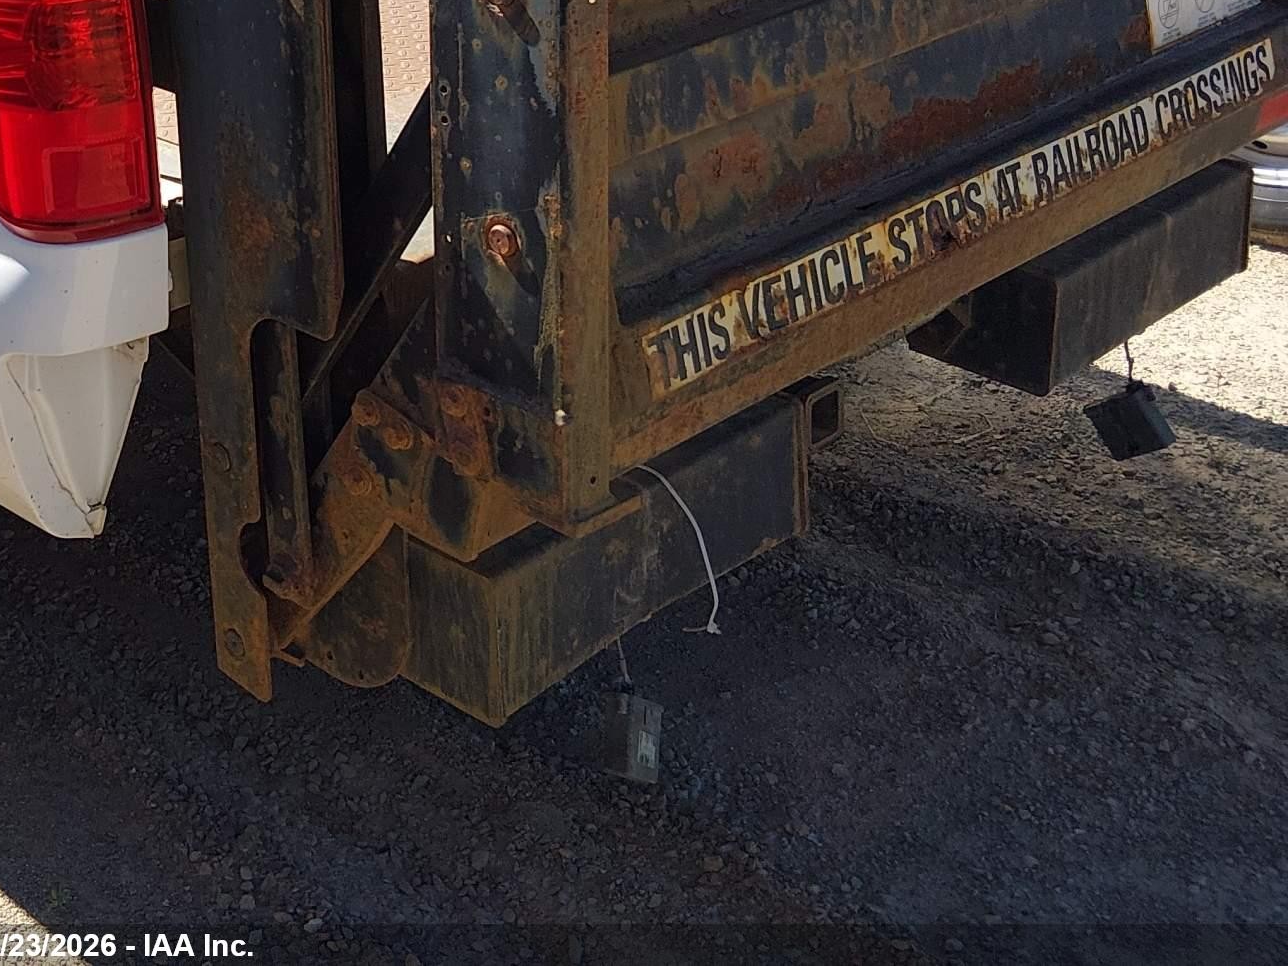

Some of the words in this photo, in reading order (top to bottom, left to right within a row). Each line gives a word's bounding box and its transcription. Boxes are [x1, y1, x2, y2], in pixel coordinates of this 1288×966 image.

[648, 302, 731, 388] THIS
[738, 232, 879, 340] VEHICLE
[887, 182, 987, 272] STOPS
[994, 162, 1023, 221] AT
[1031, 105, 1150, 203] RAILROAD
[1154, 44, 1272, 139] CROSSINGS
